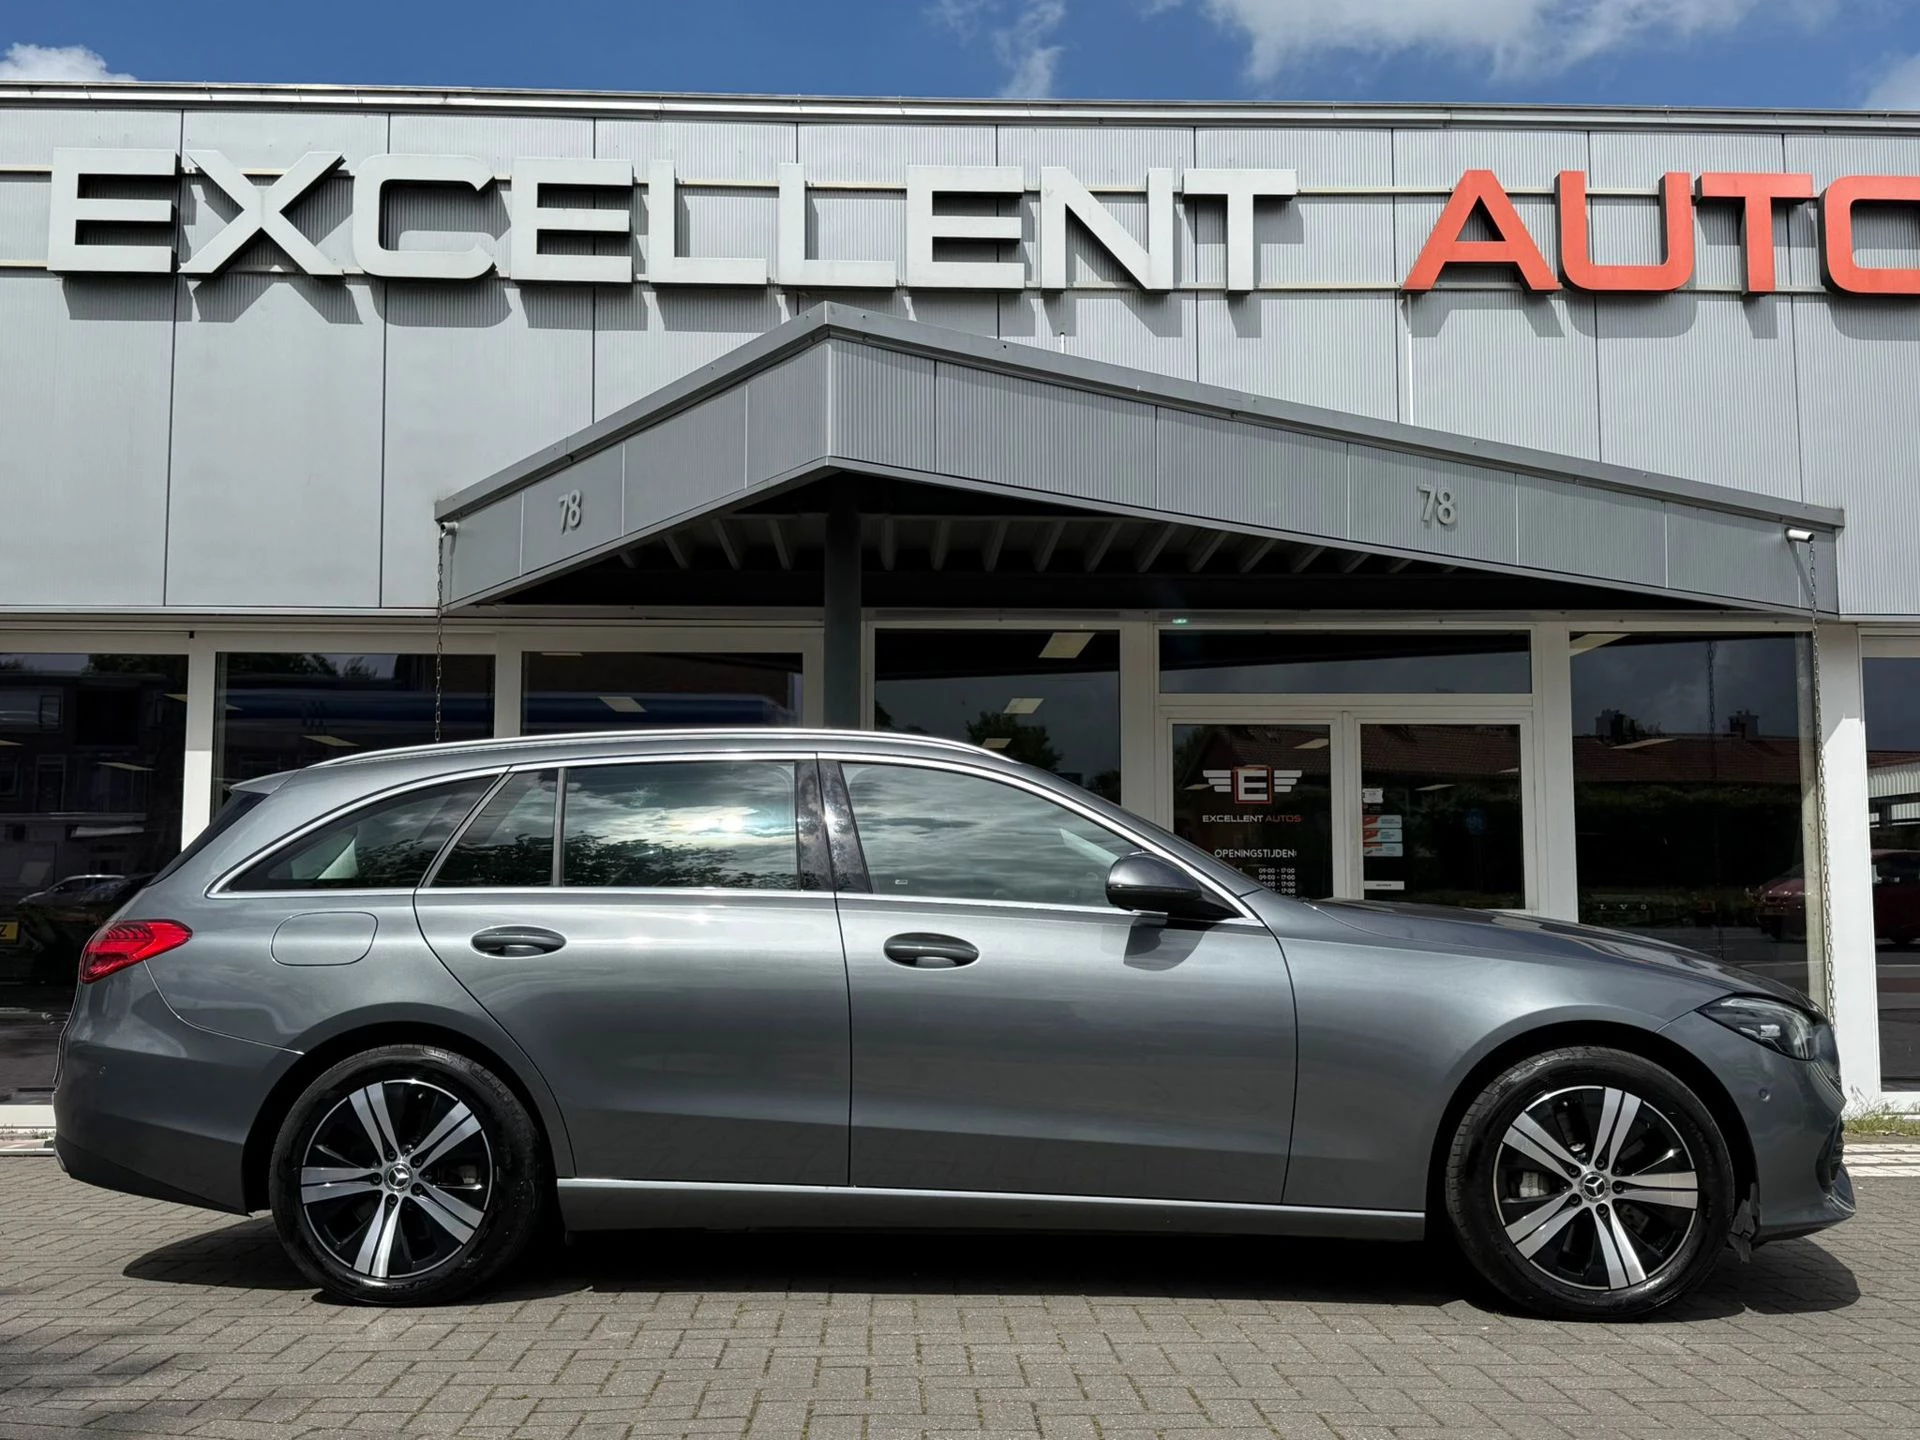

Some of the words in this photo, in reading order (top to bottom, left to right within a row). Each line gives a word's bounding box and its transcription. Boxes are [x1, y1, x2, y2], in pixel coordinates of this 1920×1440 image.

[48, 147, 1297, 292] EXCELLENT
[558, 489, 582, 534] 78
[1417, 487, 1457, 526] 78
[1202, 815, 1264, 823] EXCELLENT
[1265, 815, 1302, 823] AUTOS
